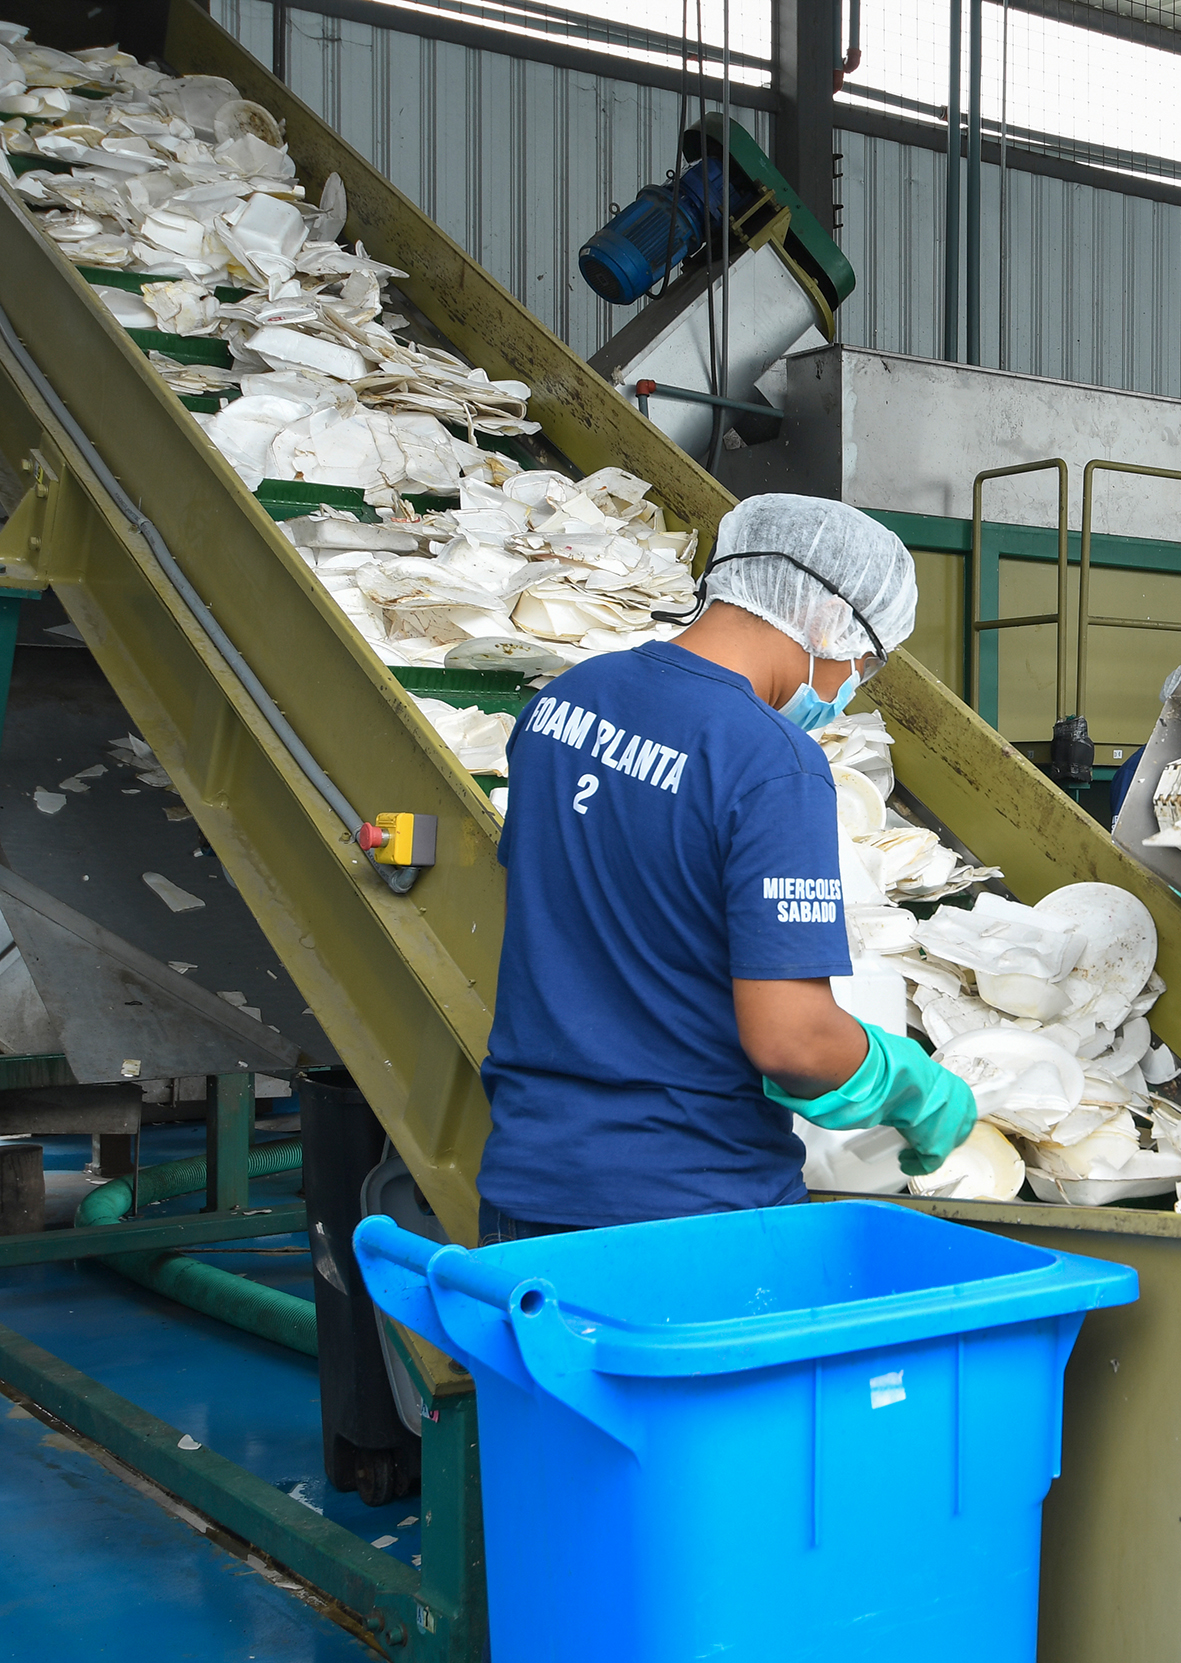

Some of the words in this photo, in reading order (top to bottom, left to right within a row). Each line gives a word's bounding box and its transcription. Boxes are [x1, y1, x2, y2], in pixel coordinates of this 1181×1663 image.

[525, 697, 597, 750] FOAM
[591, 718, 688, 795] PLANTA
[572, 773, 600, 815] 2
[763, 877, 841, 900] MIERCOLES
[777, 900, 837, 923] SABADO
